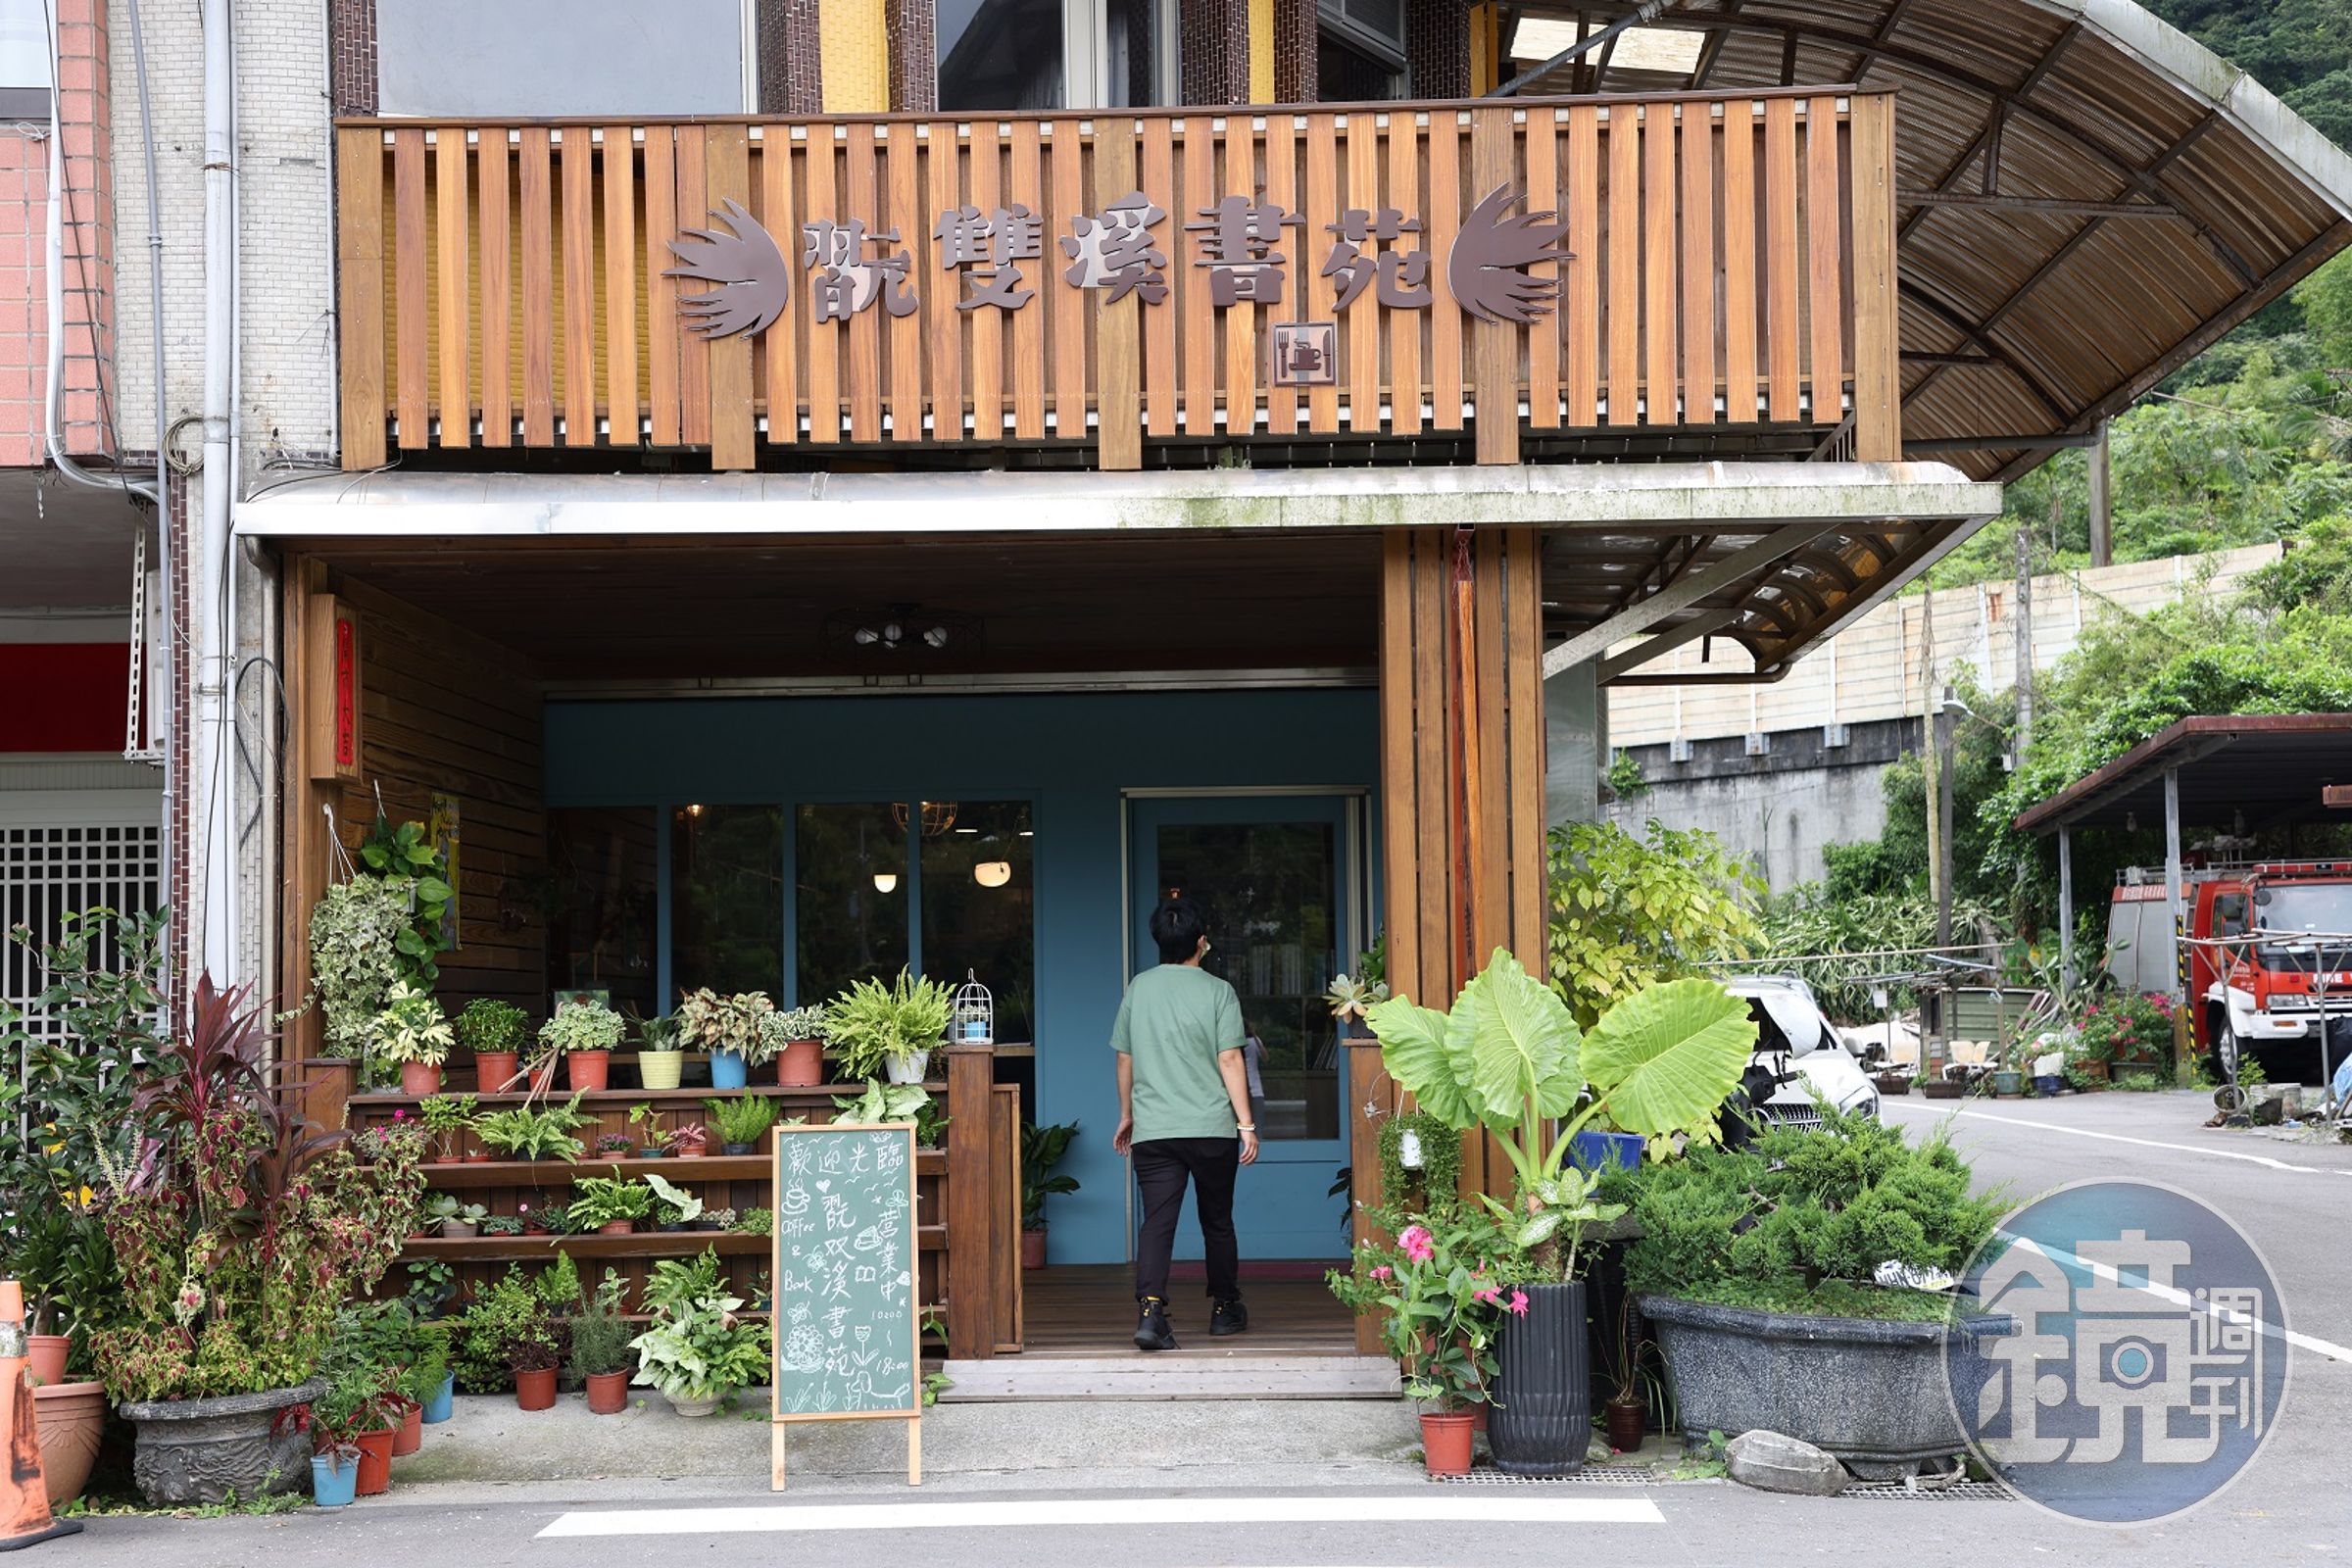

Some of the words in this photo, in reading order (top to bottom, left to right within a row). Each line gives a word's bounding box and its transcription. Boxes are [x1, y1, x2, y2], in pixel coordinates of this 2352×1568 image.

[787, 1140, 904, 1176] 歡迎光臨
[784, 1269, 813, 1294] Book
[875, 1356, 909, 1376] 18:00
